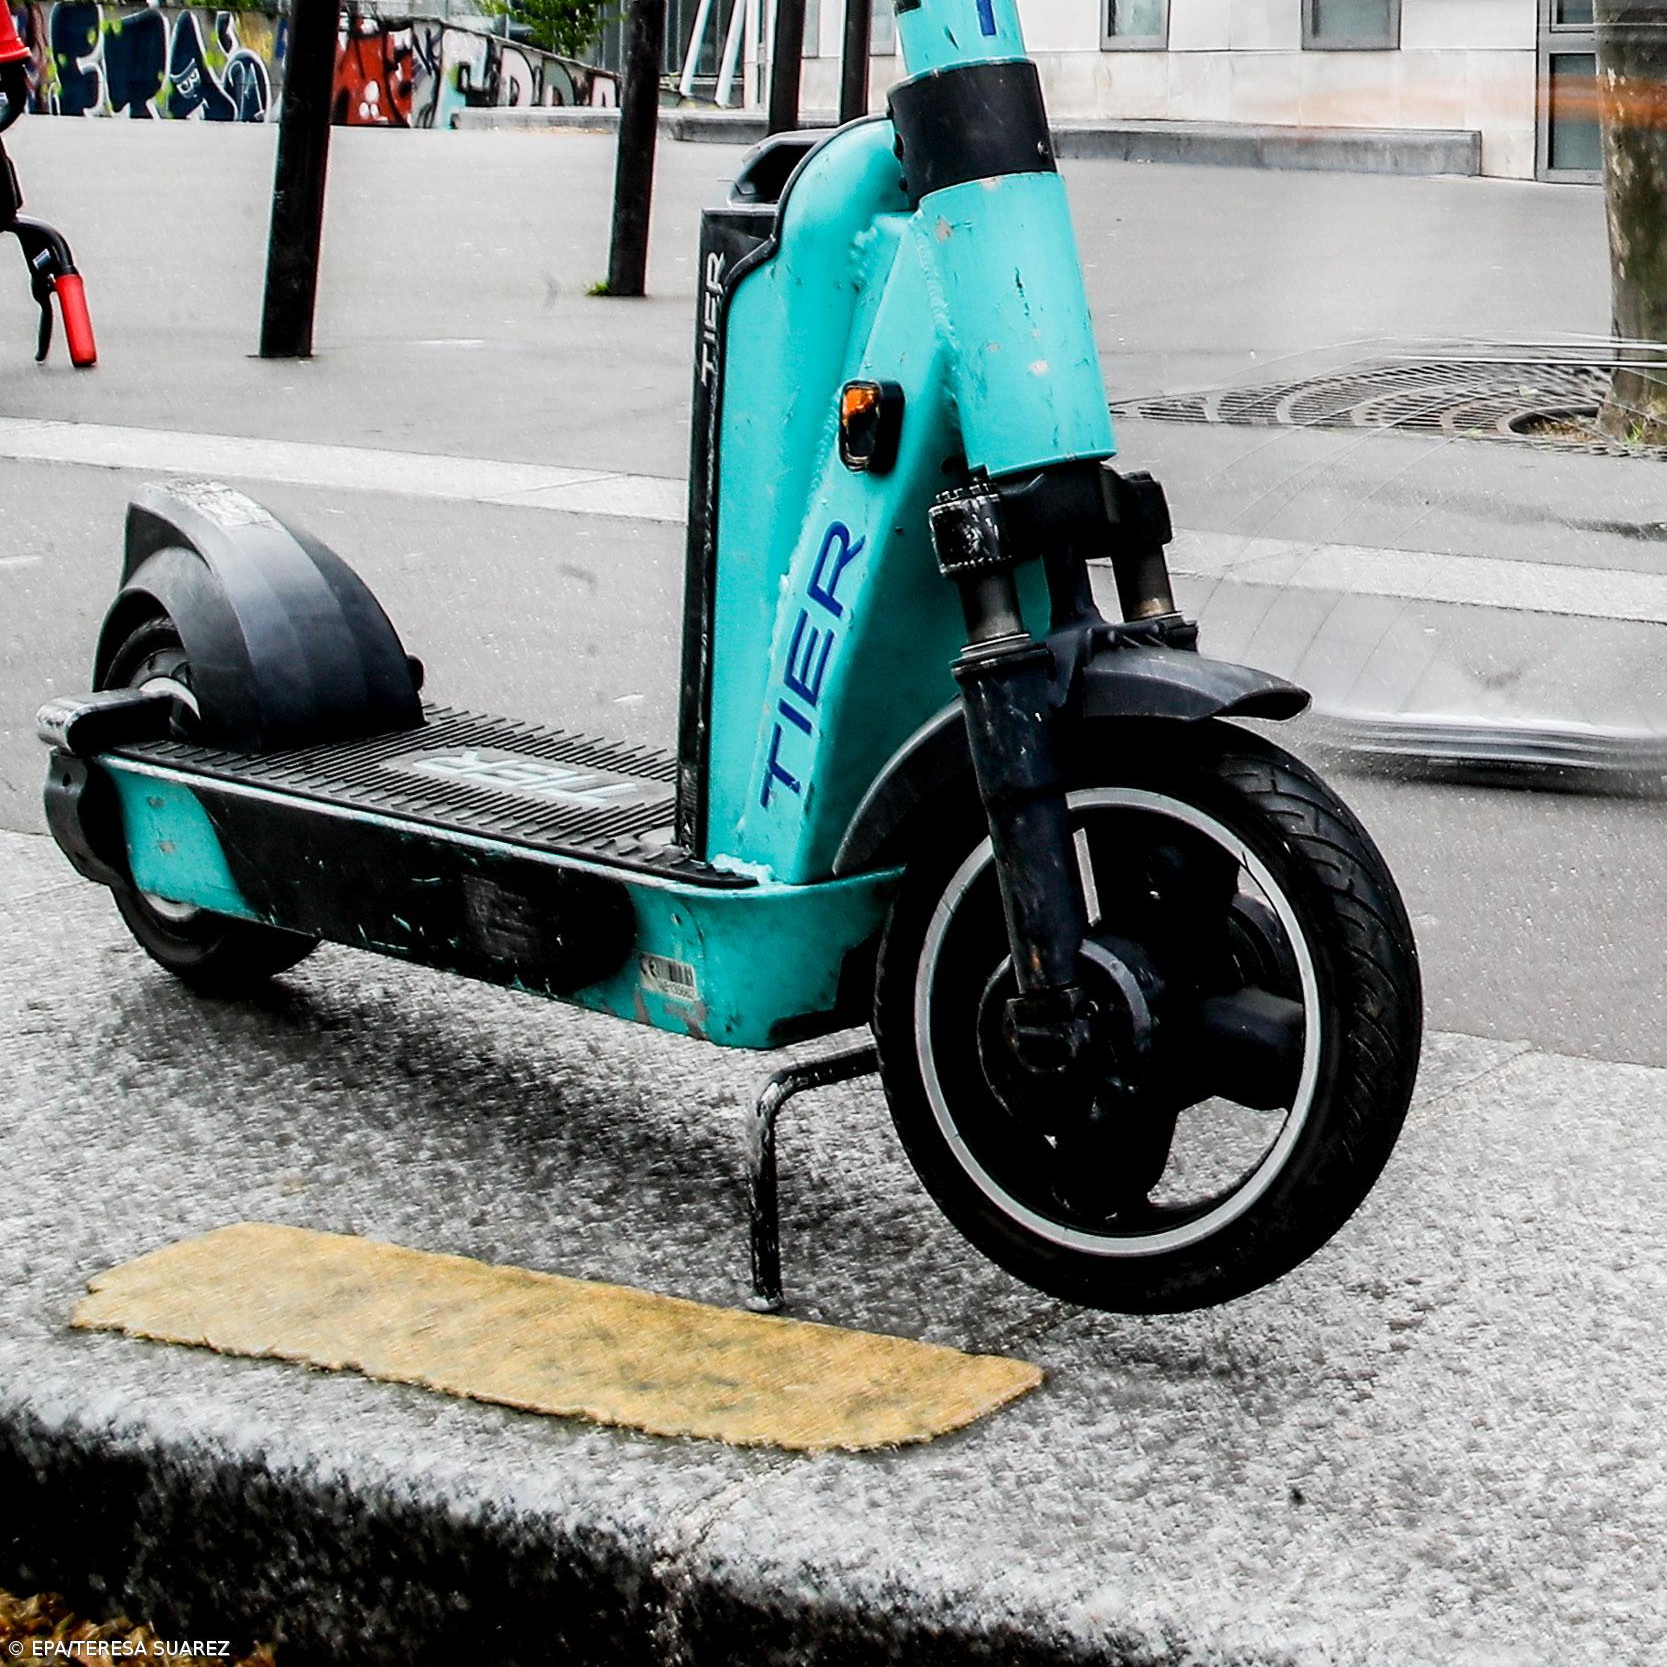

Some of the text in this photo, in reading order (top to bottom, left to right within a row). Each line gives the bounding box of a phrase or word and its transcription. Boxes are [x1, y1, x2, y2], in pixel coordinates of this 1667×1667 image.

[701, 252, 725, 386] TIER
[760, 520, 866, 808] TIER
[413, 750, 639, 805] TIER
